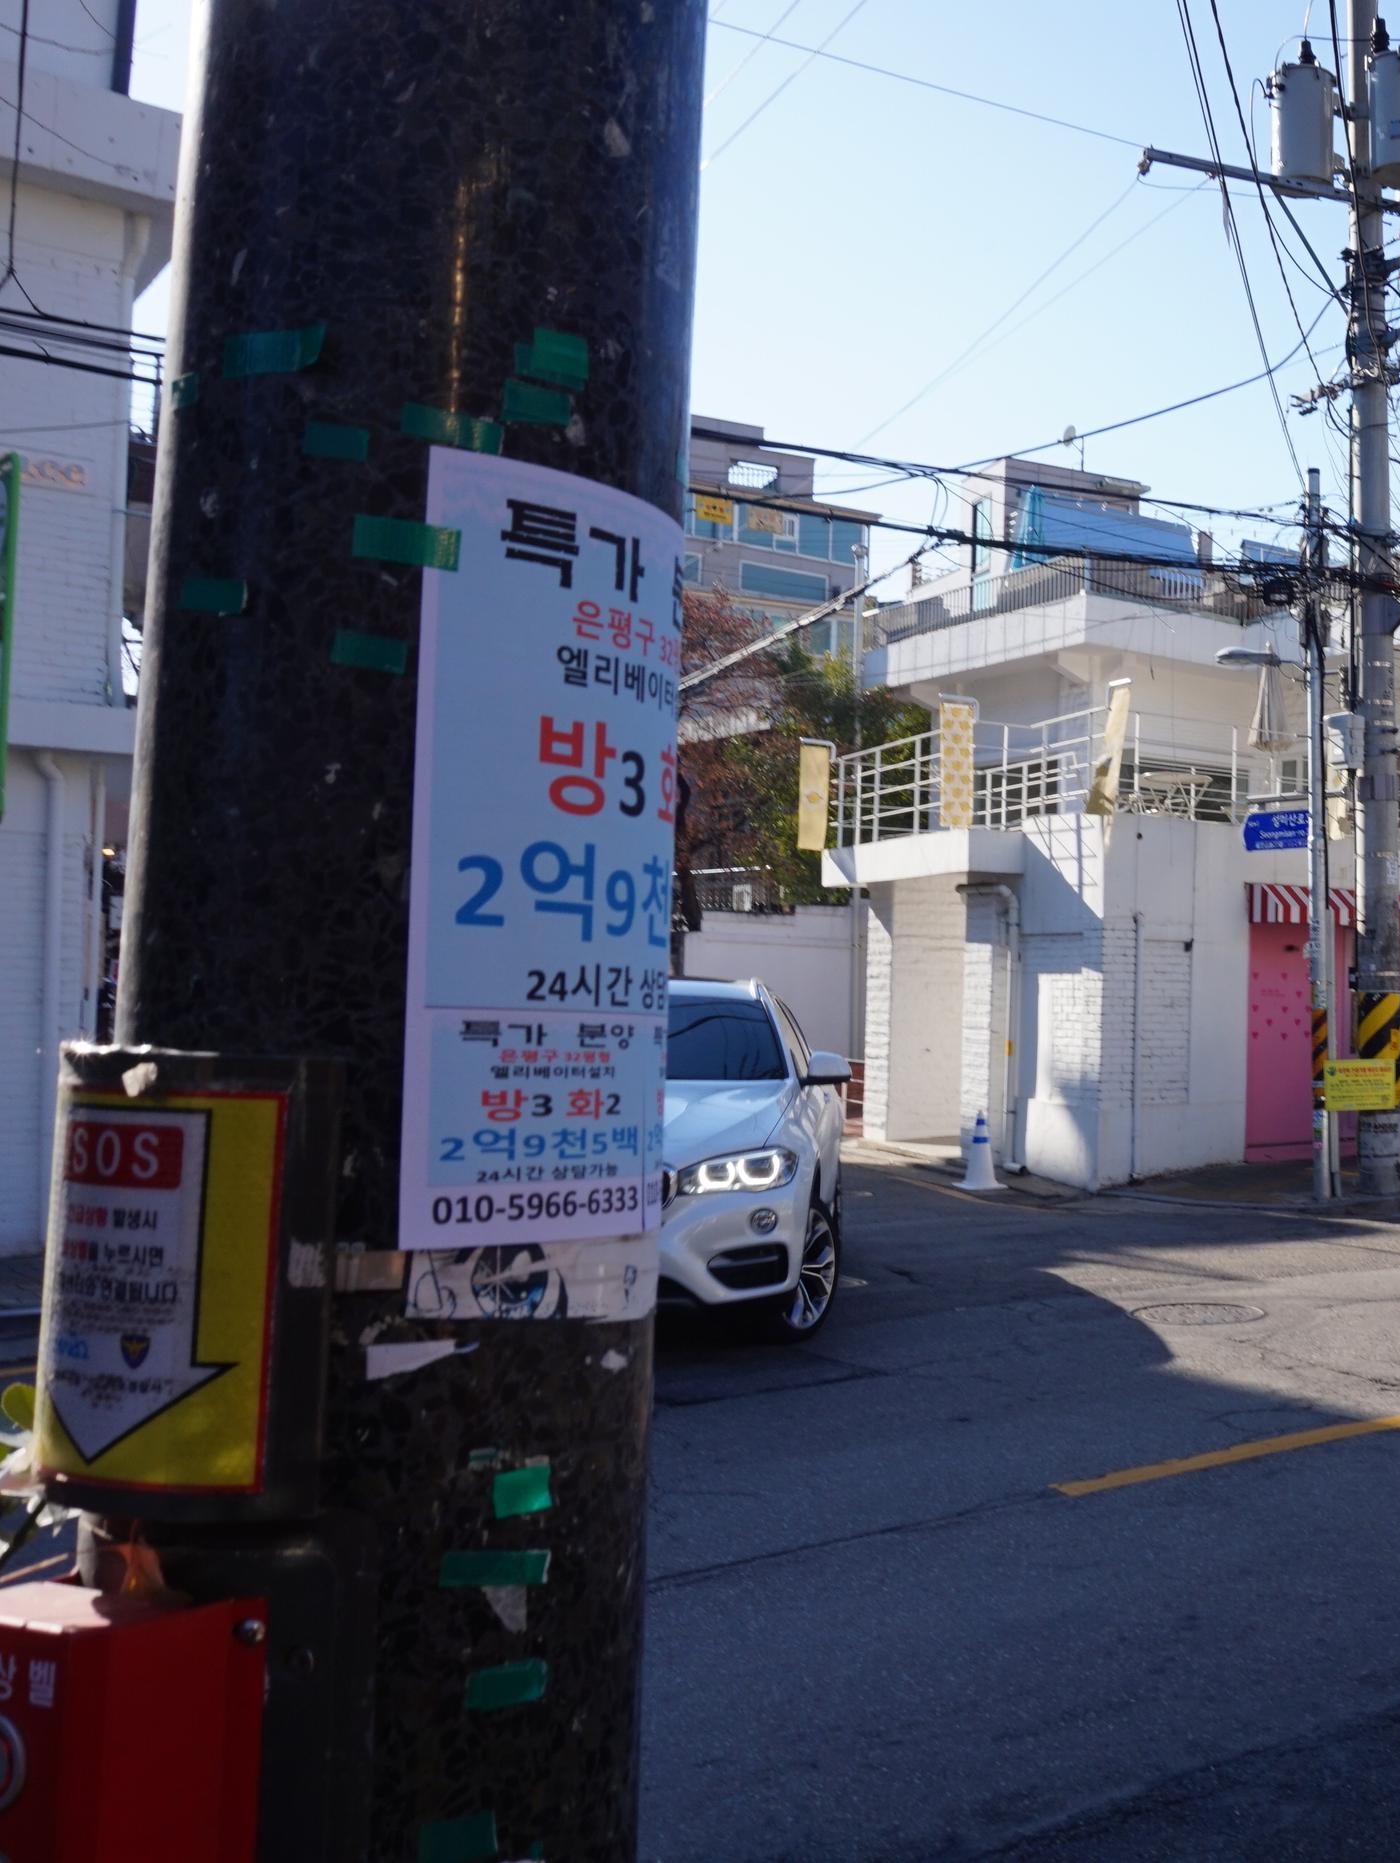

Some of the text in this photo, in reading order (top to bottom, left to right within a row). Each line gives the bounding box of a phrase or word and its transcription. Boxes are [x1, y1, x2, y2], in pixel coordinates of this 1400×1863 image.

[501, 498, 644, 602] 특가
[572, 600, 655, 656] 은평구
[539, 715, 646, 818] 방3
[455, 840, 670, 949] 2억9천
[526, 962, 633, 1007] 24시간
[459, 1019, 548, 1048] 특가
[499, 1048, 559, 1064] 은평구
[480, 1088, 554, 1122] 방3
[566, 1087, 621, 1121] 화2
[71, 1125, 160, 1180] SOS
[439, 1125, 639, 1163] 2억9천5백
[477, 1162, 619, 1184] 24시간 상담가능
[432, 1185, 639, 1226] 010-5966-6333
[104, 1243, 164, 1268] 누르시면
